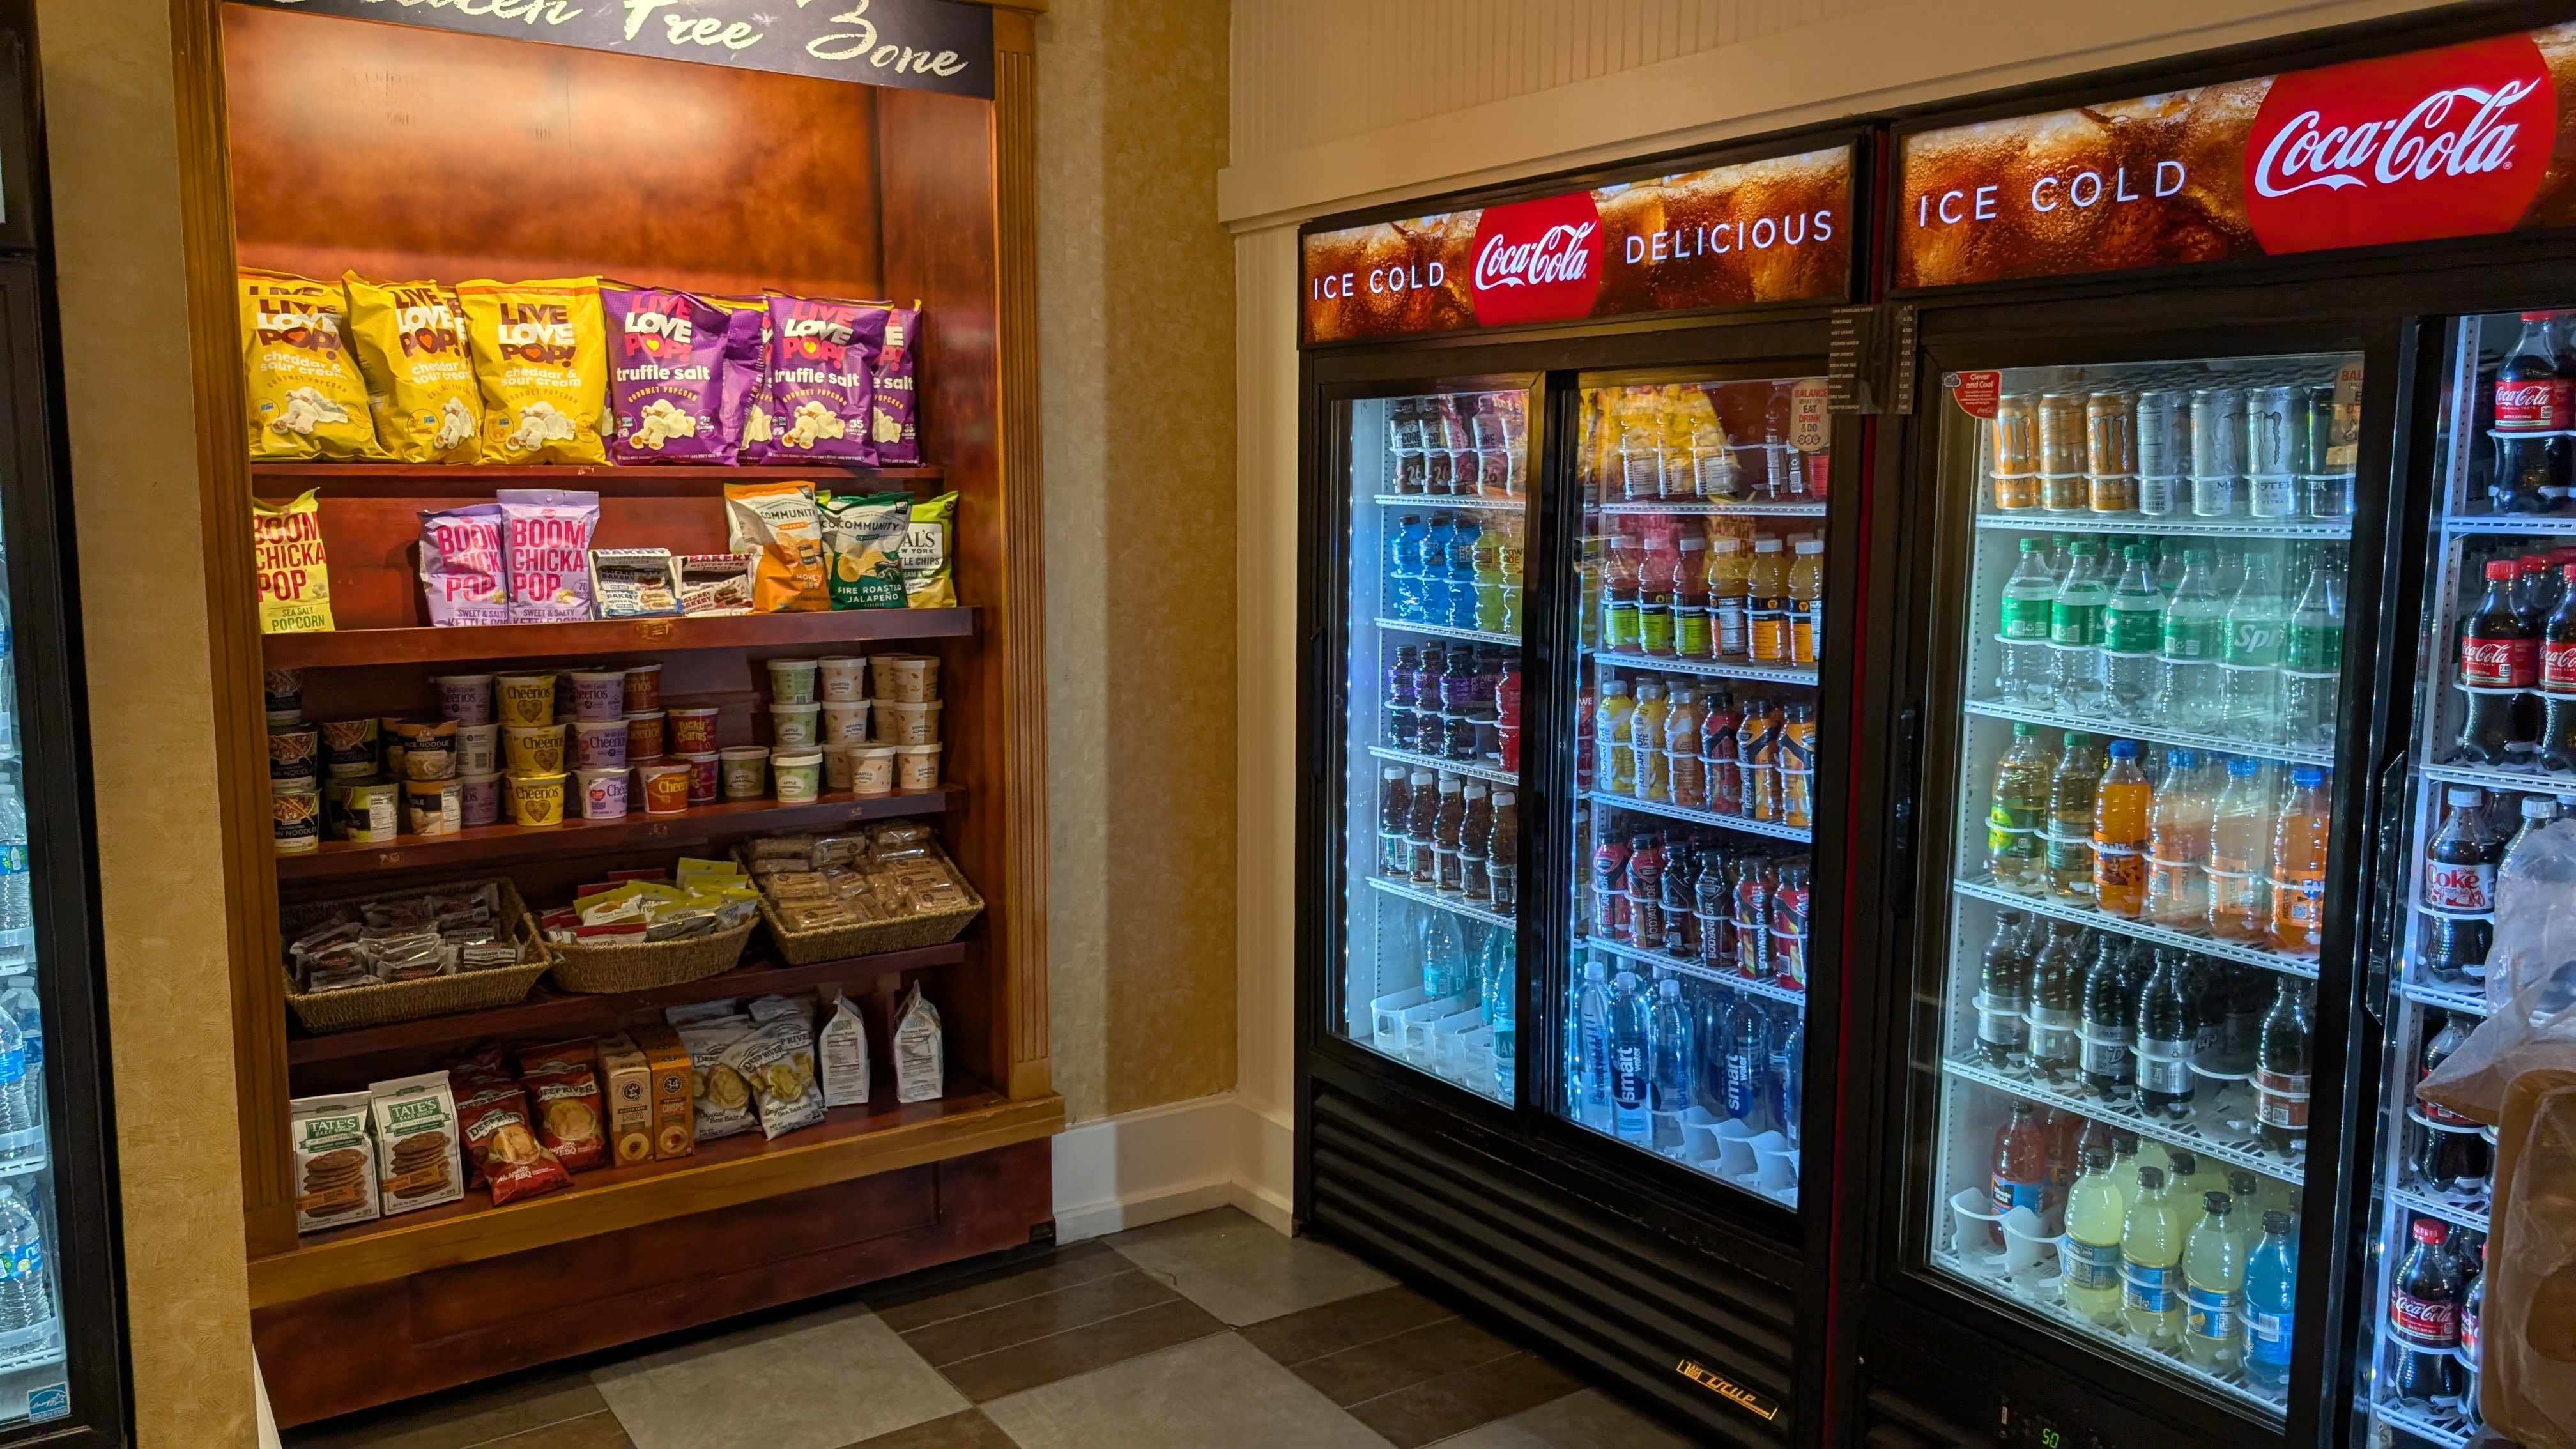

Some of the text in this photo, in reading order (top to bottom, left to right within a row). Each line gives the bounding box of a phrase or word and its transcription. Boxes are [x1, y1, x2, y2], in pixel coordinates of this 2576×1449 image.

[1919, 77, 2542, 227] ICE COLD Coca-Cola
[1314, 210, 1834, 300] ICE COLD Coca-Cola DELICIOUS
[259, 299, 339, 314] LIVE
[388, 288, 446, 309] LIVE
[631, 294, 692, 320] LIVE
[257, 312, 343, 332] LOVE
[395, 305, 455, 333] LOVE
[500, 303, 569, 325] LIVE
[793, 302, 857, 328] LIVE
[498, 323, 576, 346] LOVE
[625, 312, 693, 344] LOVE
[785, 319, 854, 347] LOVE
[257, 327, 343, 360] POP!
[399, 327, 461, 358] POP!
[624, 334, 693, 362] POP!
[498, 343, 577, 368] POP!
[783, 336, 846, 370] POP!
[260, 362, 348, 381] sour cream
[263, 351, 342, 374] cheddar &
[411, 359, 459, 376] cheddar
[413, 372, 440, 385] sour
[501, 377, 581, 387] sour cream
[506, 367, 577, 379] cheddar &
[616, 364, 711, 382] truffle salt
[774, 367, 861, 388] truffle salt
[884, 375, 914, 391] salt
[506, 388, 579, 404] GOURMET POPCORN
[628, 385, 698, 404] GOURMET POPCORN
[783, 388, 849, 406] GOURMET POPCORN
[1795, 388, 1828, 398] BALANCE
[2496, 385, 2552, 406] Coca-Cola
[1803, 404, 1817, 414] EAT
[849, 419, 864, 429] 35
[1798, 414, 1821, 423] DRINK
[1800, 423, 1818, 433] & DO
[1402, 432, 1421, 444] CORE
[1406, 465, 1422, 480] 26
[1433, 465, 1449, 480] 26
[512, 519, 586, 550] BOOM
[839, 521, 900, 532] COMMUNITY
[901, 529, 937, 548] AL'S
[256, 541, 326, 571] CHICKA
[512, 548, 585, 574] CHICKA
[916, 557, 940, 568] CHIPS
[258, 569, 307, 603] POP
[447, 574, 496, 602] POP
[512, 572, 561, 604] POP
[578, 581, 588, 592] 70
[837, 586, 857, 595] FIRE
[862, 584, 902, 595] ROASTED
[847, 593, 899, 604] JALAPEÑO
[282, 606, 314, 618] SEA SALT
[458, 609, 482, 620] SWEET
[483, 610, 489, 618] &
[523, 607, 575, 619] SWEET & SALTY
[272, 614, 325, 632] POPCORN
[2462, 640, 2511, 663] Coca-Cola
[507, 686, 551, 700] Cheerios
[678, 720, 707, 732] Lucky
[677, 730, 707, 742] Charms
[516, 785, 558, 800] Cheerios
[2427, 862, 2480, 890] Coke
[743, 1045, 784, 1070] DEEP RIVER
[1622, 1046, 1641, 1103] smart water
[1726, 1052, 1748, 1111] smart water
[562, 1084, 595, 1094] RIVER
[391, 1100, 437, 1117] TATE'S
[399, 1113, 415, 1121] BAKE
[622, 1112, 644, 1122] CRISPS
[662, 1103, 684, 1113] CRISPS
[790, 1107, 802, 1116] Salt
[309, 1119, 356, 1133] TATE'S
[468, 1119, 496, 1138] DEEP
[558, 1147, 576, 1156] BBQ
[514, 1170, 532, 1181] BBQ
[2396, 1296, 2455, 1323] Coca-Cola
